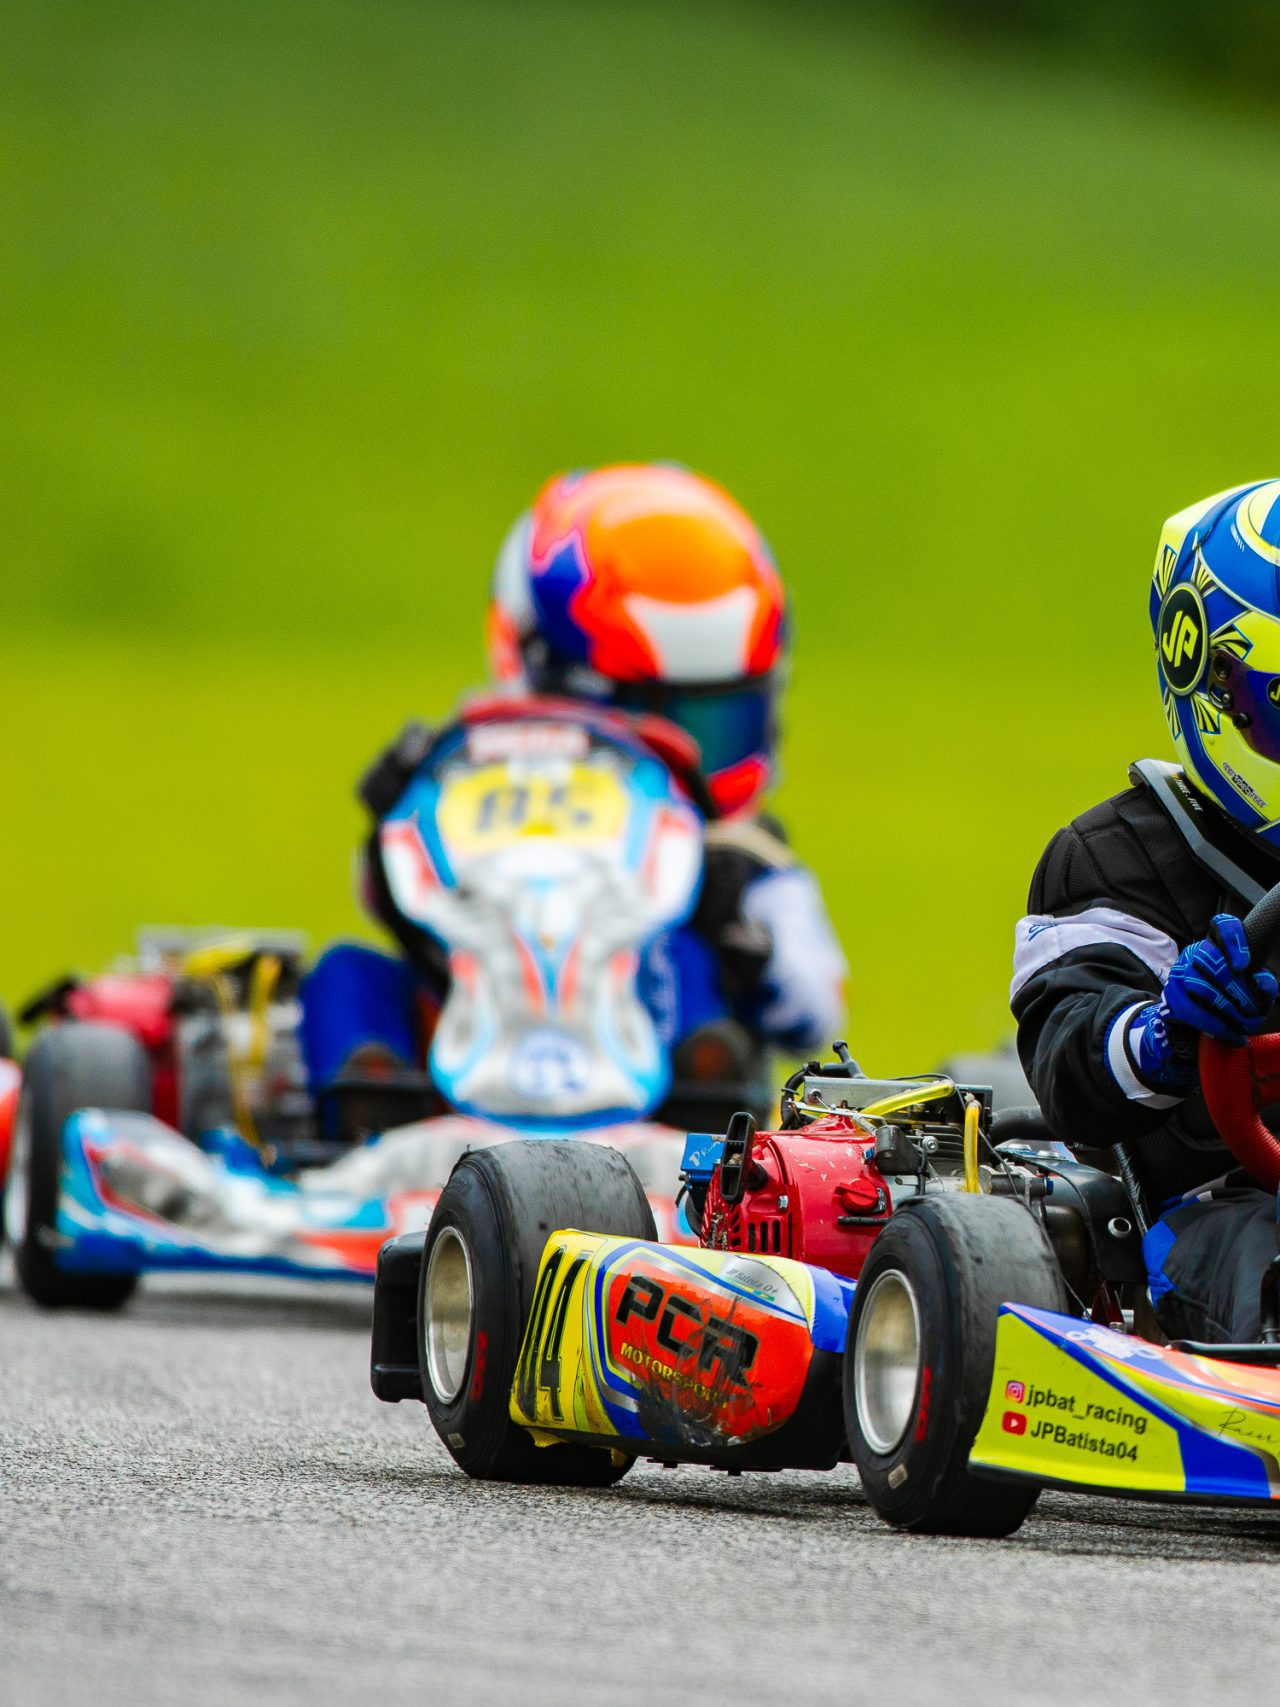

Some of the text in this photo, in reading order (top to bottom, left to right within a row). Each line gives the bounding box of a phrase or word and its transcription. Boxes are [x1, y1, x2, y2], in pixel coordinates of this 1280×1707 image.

[1162, 610, 1198, 668] JP
[615, 1273, 761, 1389] PCR
[620, 1342, 729, 1409] MOTORSOR
[1026, 1385, 1147, 1435] jpbat_racing
[1031, 1421, 1138, 1462] JPBatista04
